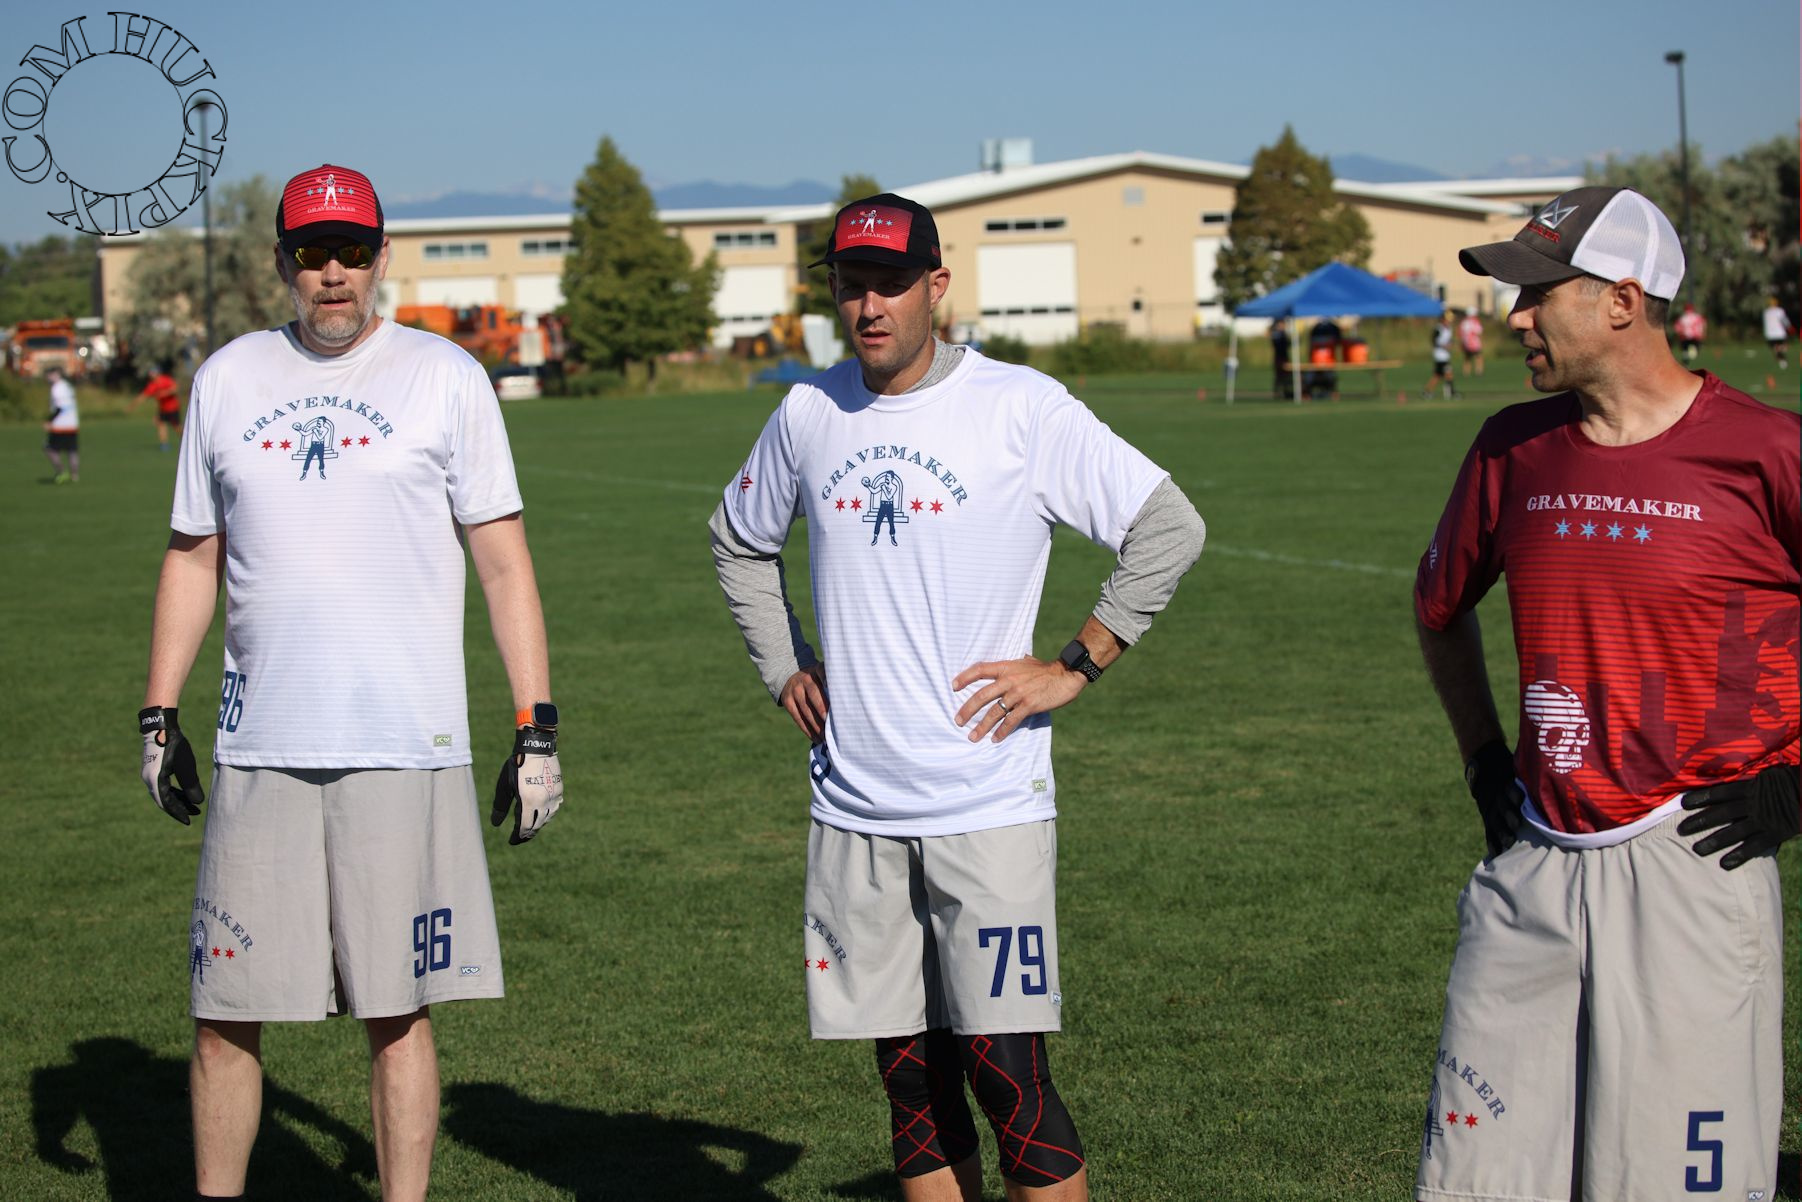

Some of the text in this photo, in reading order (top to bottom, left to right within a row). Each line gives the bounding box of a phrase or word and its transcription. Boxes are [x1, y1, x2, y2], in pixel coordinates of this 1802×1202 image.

[307, 205, 356, 214] GRAVEMAKER
[847, 231, 891, 240] GRAVEMAKER
[243, 396, 394, 442] GRAVEMAKER
[821, 445, 968, 507] GRAVEMAKER
[1526, 493, 1703, 522] GRAVEMAKER
[218, 670, 247, 733] 96
[522, 739, 552, 749] LAYOUT
[413, 907, 452, 979] 96
[978, 925, 1048, 998] 79
[1685, 1110, 1724, 1192] 5
